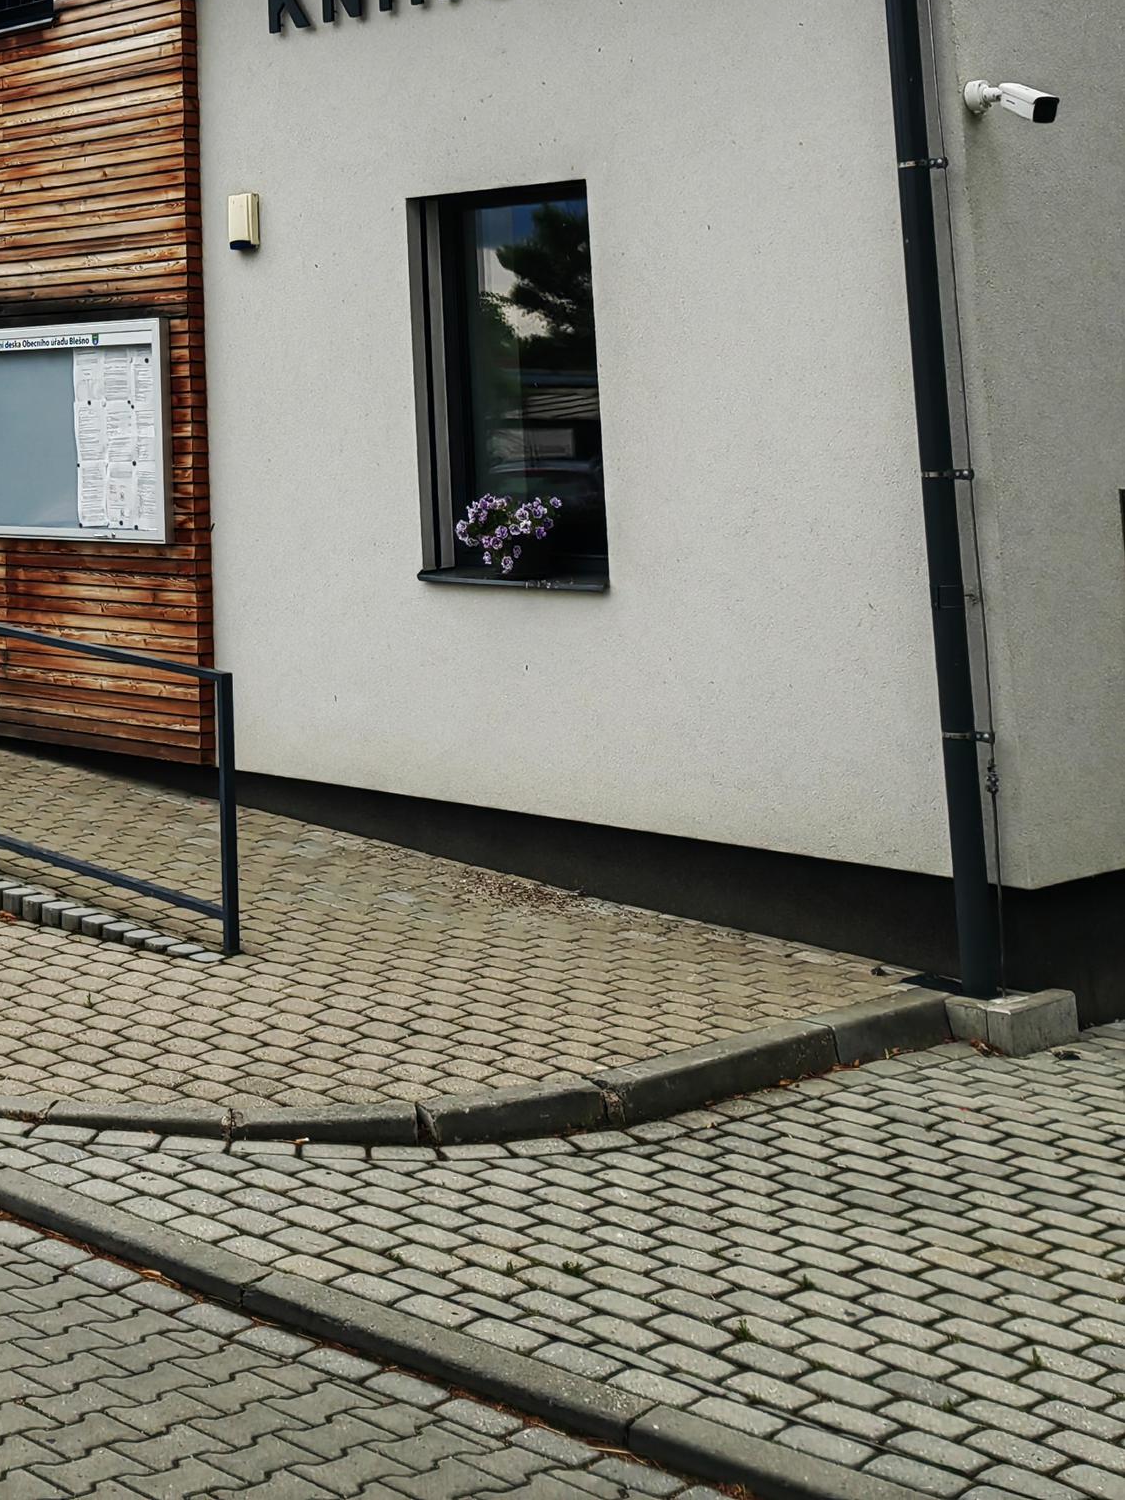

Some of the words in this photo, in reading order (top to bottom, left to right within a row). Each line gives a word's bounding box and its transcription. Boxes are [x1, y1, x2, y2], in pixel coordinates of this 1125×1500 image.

[5, 341, 21, 349] deska
[22, 338, 50, 348] Obecního
[69, 337, 90, 345] Blešno
